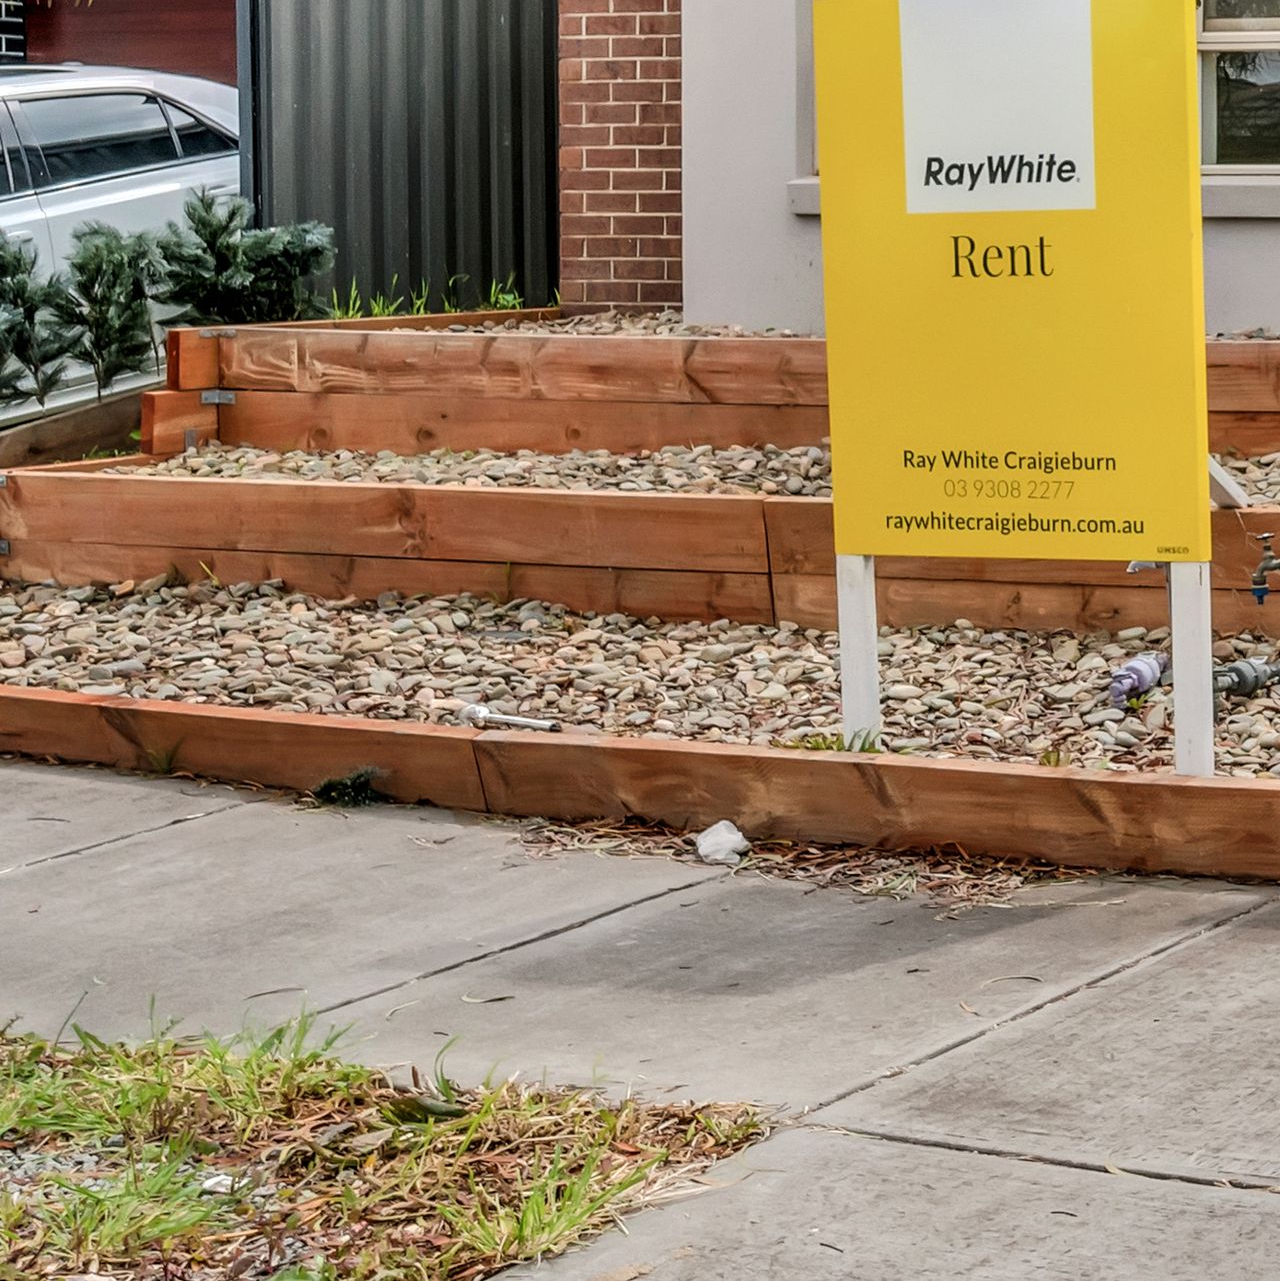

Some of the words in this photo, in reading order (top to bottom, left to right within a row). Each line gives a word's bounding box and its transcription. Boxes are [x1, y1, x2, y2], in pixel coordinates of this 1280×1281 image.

[949, 235, 1055, 278] Rent
[902, 449, 937, 472] Ray
[941, 450, 999, 470] White
[1003, 451, 1117, 474] Craigieburn
[943, 479, 968, 498] 03
[973, 479, 1022, 499] 9308
[1026, 480, 1076, 500] 2277
[885, 510, 1145, 535] raywhitecraigieburn.com.au
